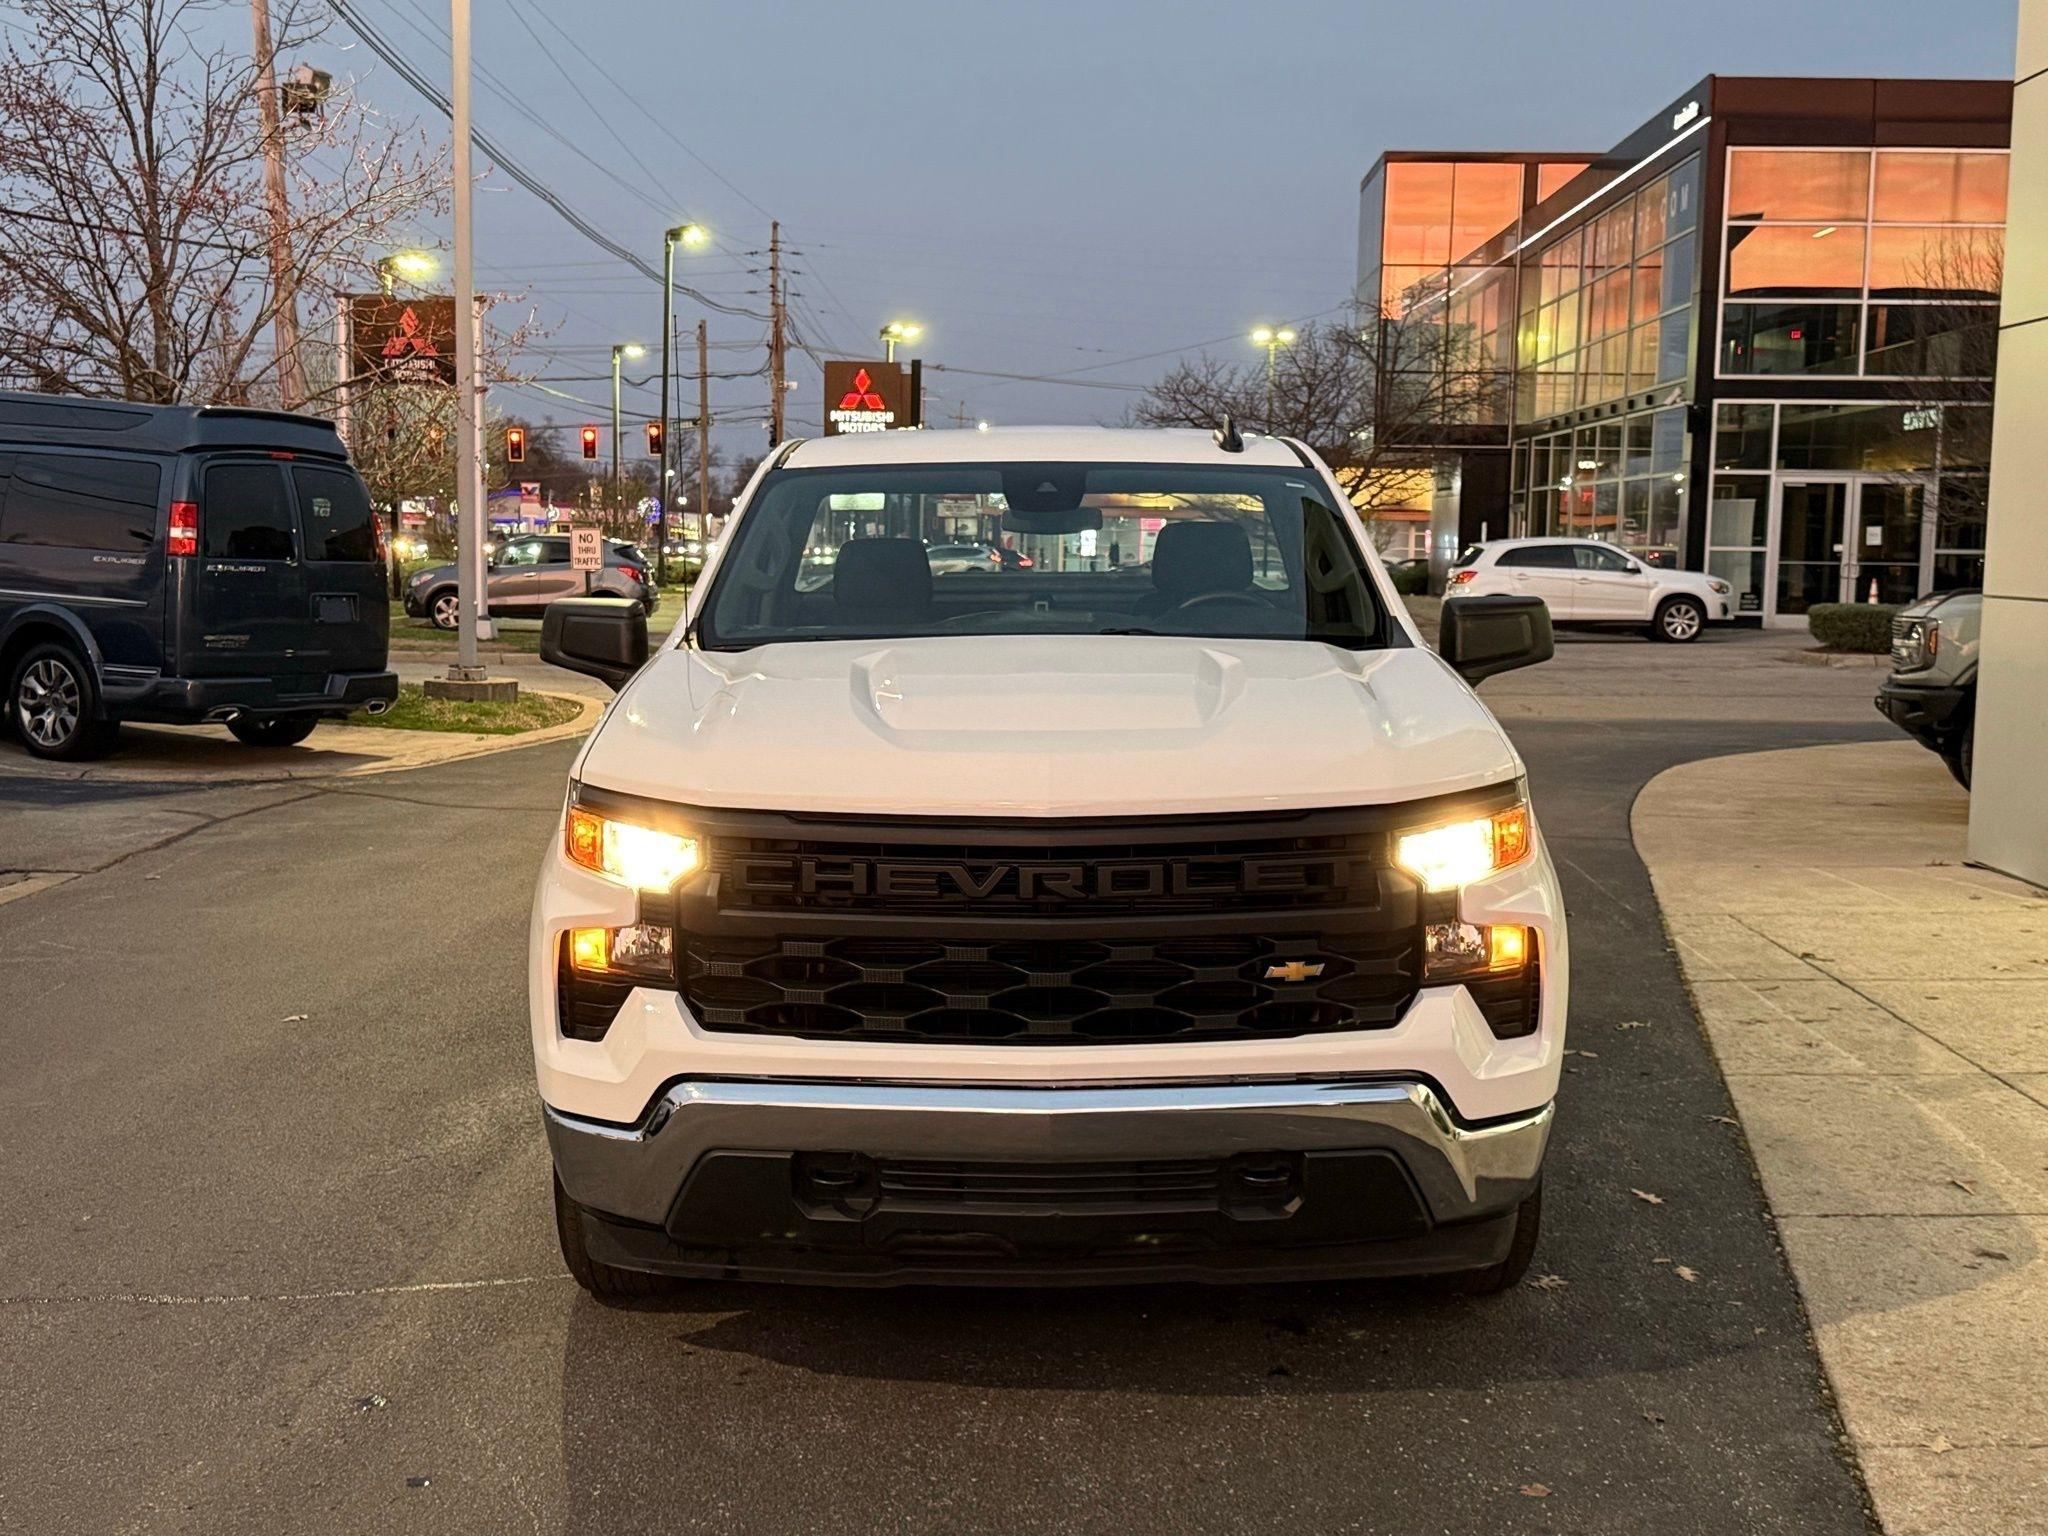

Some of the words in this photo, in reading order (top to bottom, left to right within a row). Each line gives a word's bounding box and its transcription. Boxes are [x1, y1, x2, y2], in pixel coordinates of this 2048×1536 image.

[830, 410, 895, 423] MITSUBISHI
[838, 421, 886, 433] MOTORS
[579, 533, 593, 544] NO
[578, 546, 596, 555] THRU
[574, 557, 600, 565] TRAFFIC
[733, 856, 1370, 898] CHEVROLET
